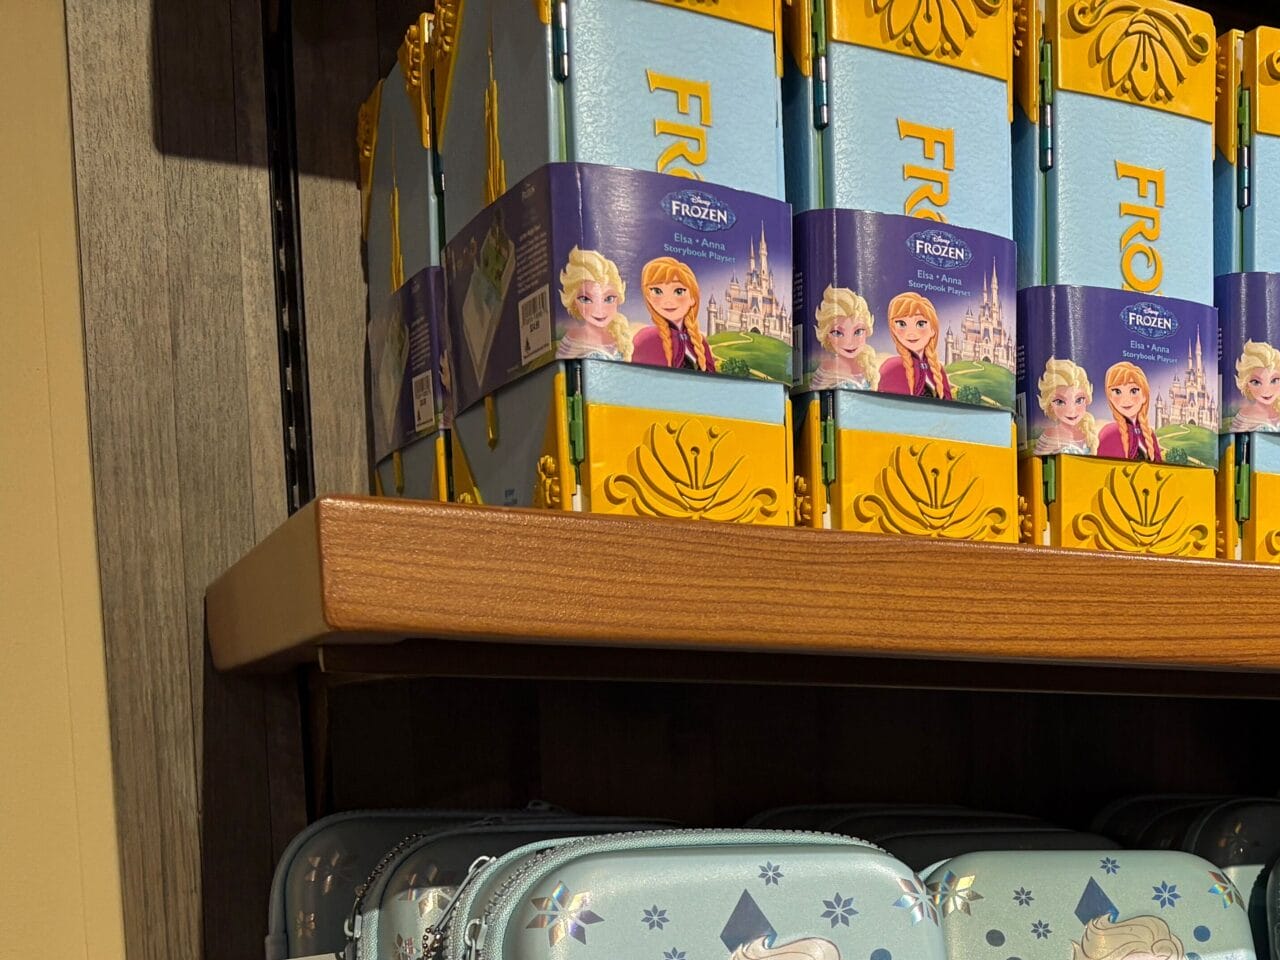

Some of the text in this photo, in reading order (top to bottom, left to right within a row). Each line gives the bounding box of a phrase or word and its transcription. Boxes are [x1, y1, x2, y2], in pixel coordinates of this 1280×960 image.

[646, 69, 712, 182] FR
[896, 117, 955, 224] FR
[671, 201, 728, 223] FROZEN
[1115, 159, 1166, 296] FRO
[663, 243, 707, 259] Storybook
[674, 233, 726, 251] Elsa Anna
[915, 240, 965, 261] FROZEN
[908, 279, 946, 293] Storybook
[917, 269, 962, 285] Elsa Anna
[1129, 312, 1172, 330] FROZEN
